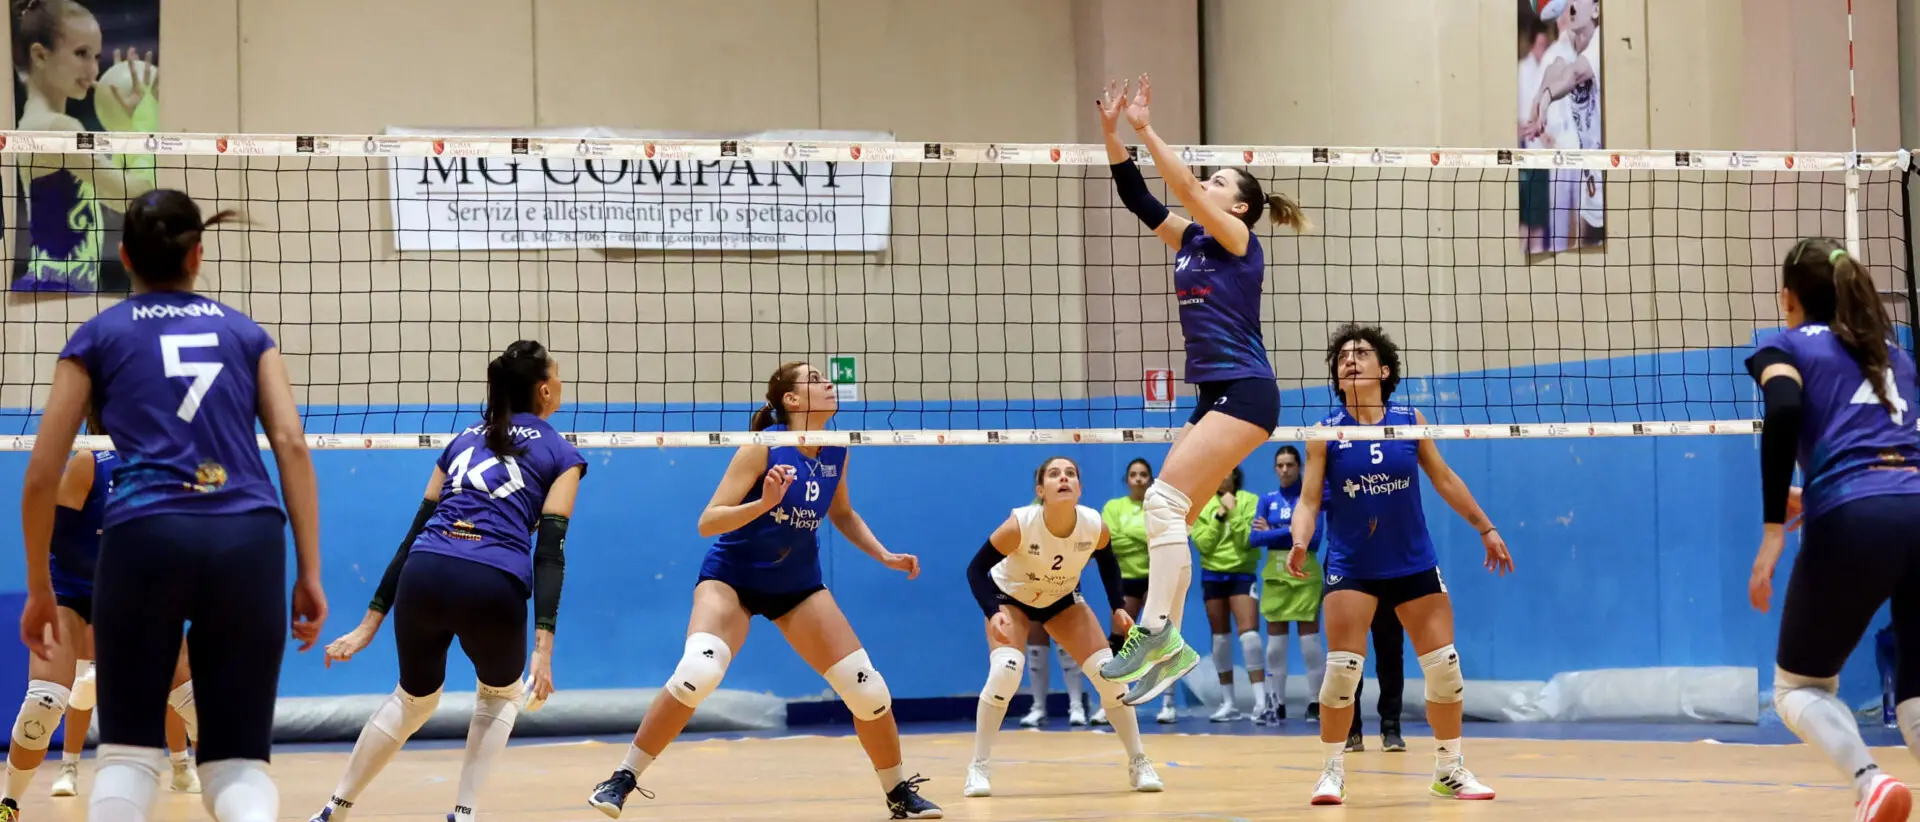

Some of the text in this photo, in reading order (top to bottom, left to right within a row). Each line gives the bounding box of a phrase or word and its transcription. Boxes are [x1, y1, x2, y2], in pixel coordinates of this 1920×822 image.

[418, 156, 841, 188] MG COMPANY
[447, 201, 836, 230] Servizi e allestimenti per lo spettacolo
[132, 303, 225, 321] MORENA
[159, 332, 225, 424] 5
[1369, 442, 1384, 465] 5
[448, 446, 526, 500] 10
[1359, 472, 1391, 485] New
[805, 480, 820, 502] 19
[1361, 476, 1410, 496] Hospital
[790, 506, 818, 519] New
[1280, 507, 1291, 520] 18
[1051, 554, 1064, 571] 2
